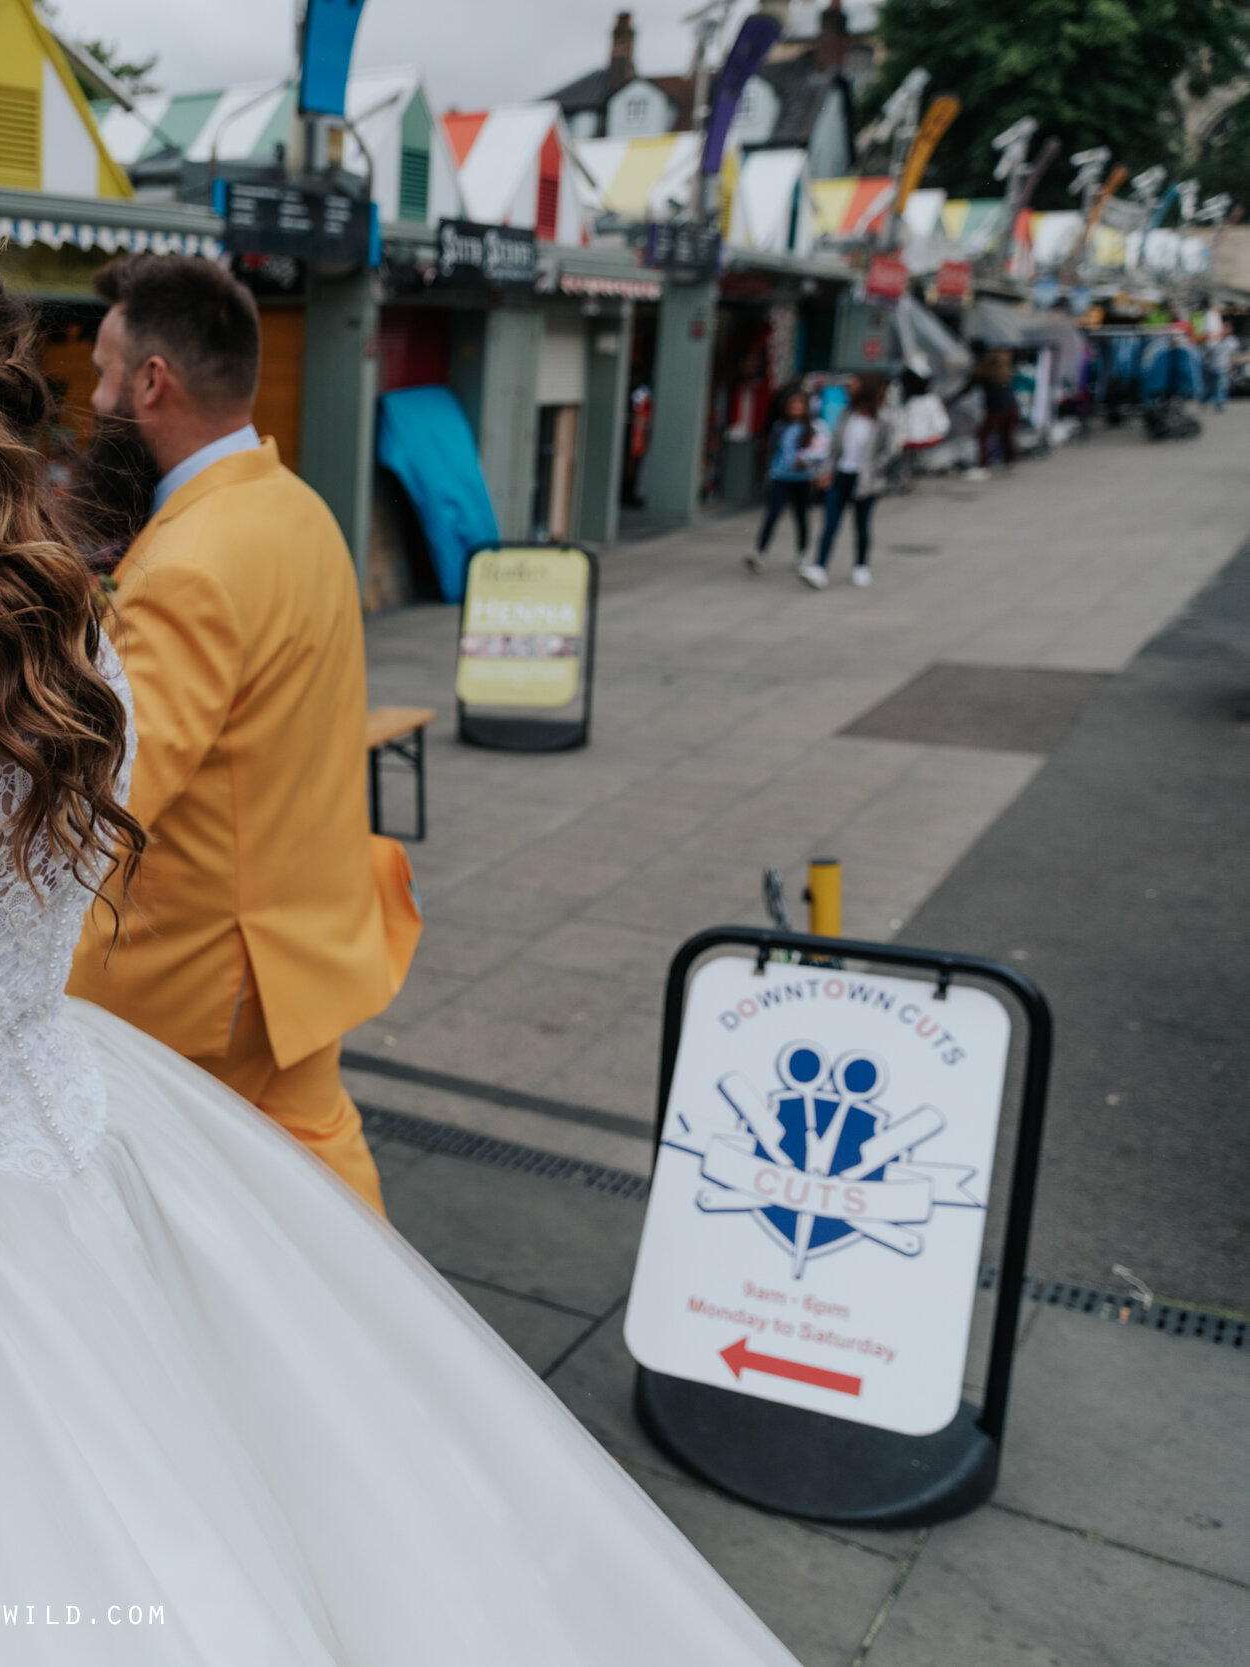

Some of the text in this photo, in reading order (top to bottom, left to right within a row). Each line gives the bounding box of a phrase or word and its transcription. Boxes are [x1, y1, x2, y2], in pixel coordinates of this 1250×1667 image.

[719, 978, 966, 1066] DOWNTOWN CUTS
[753, 1167, 867, 1215] CUTS
[743, 1280, 787, 1304] 9am
[803, 1294, 849, 1319] 6pm
[687, 1296, 897, 1364] Monday to Saturday
